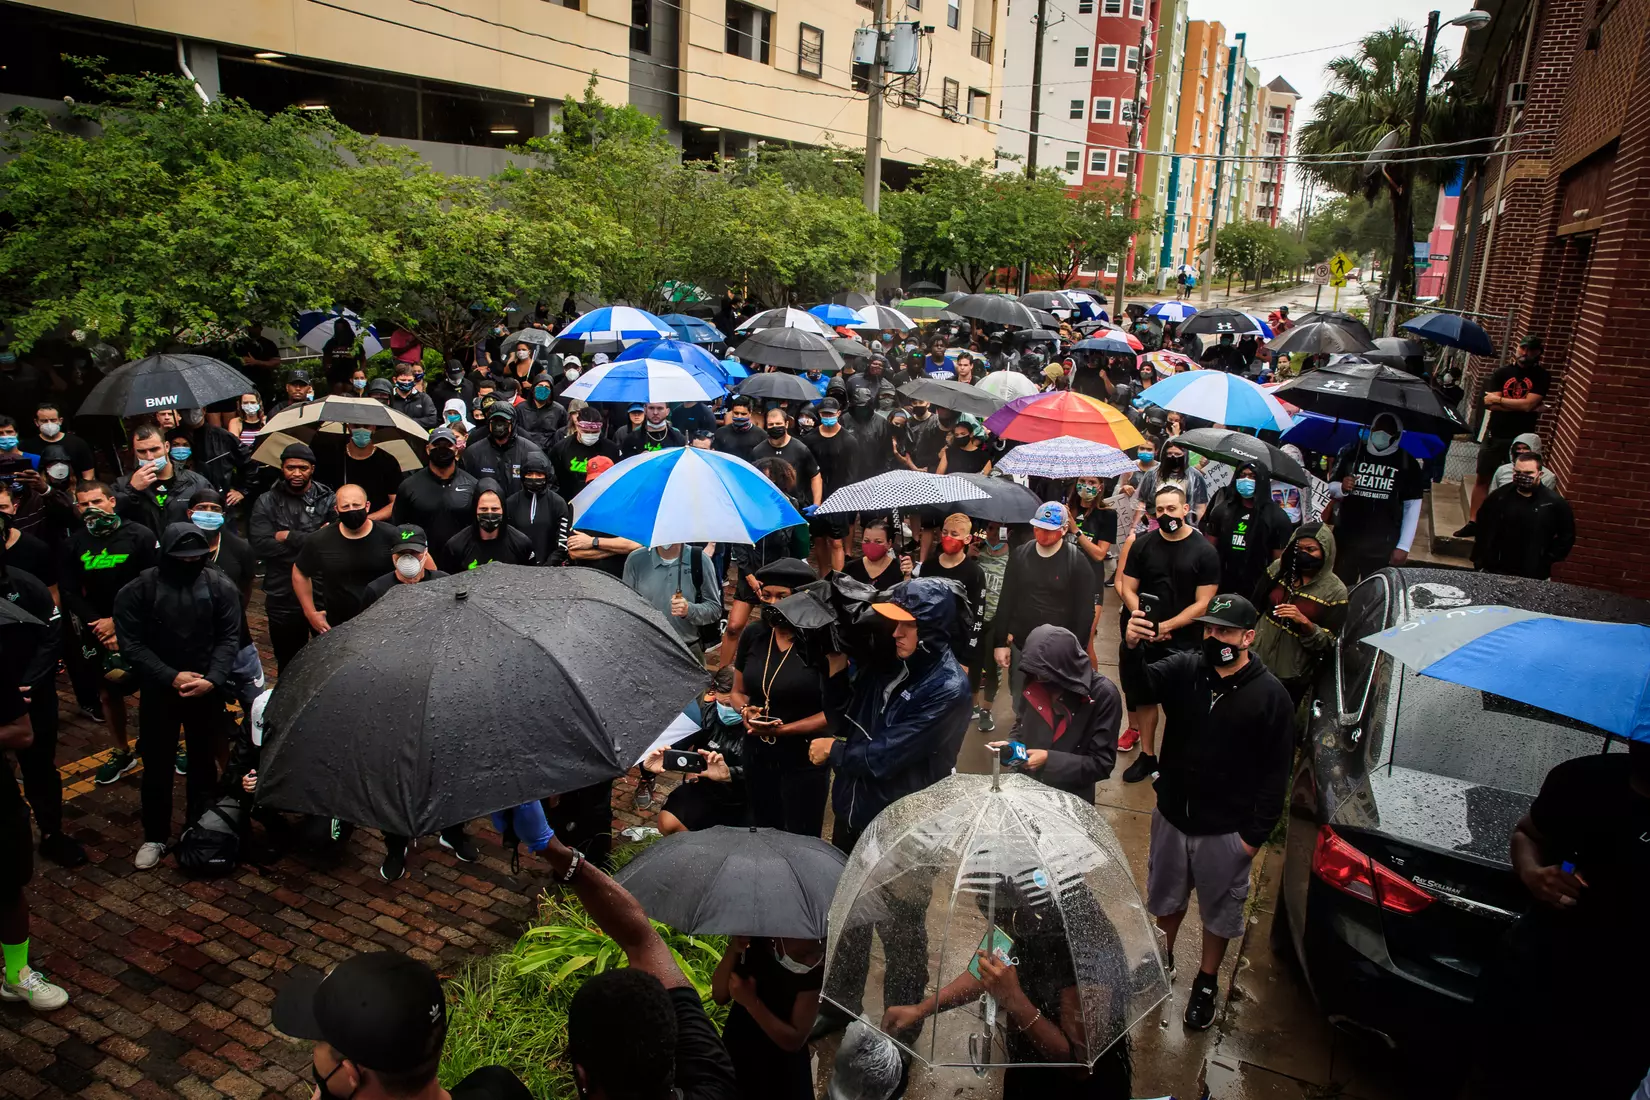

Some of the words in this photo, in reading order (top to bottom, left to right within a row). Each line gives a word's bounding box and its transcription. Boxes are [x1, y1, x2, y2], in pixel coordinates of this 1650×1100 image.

[145, 394, 178, 408] BMW
[1358, 462, 1399, 478] CAN'T
[1353, 473, 1395, 491] REATHE
[80, 547, 130, 570] USF
